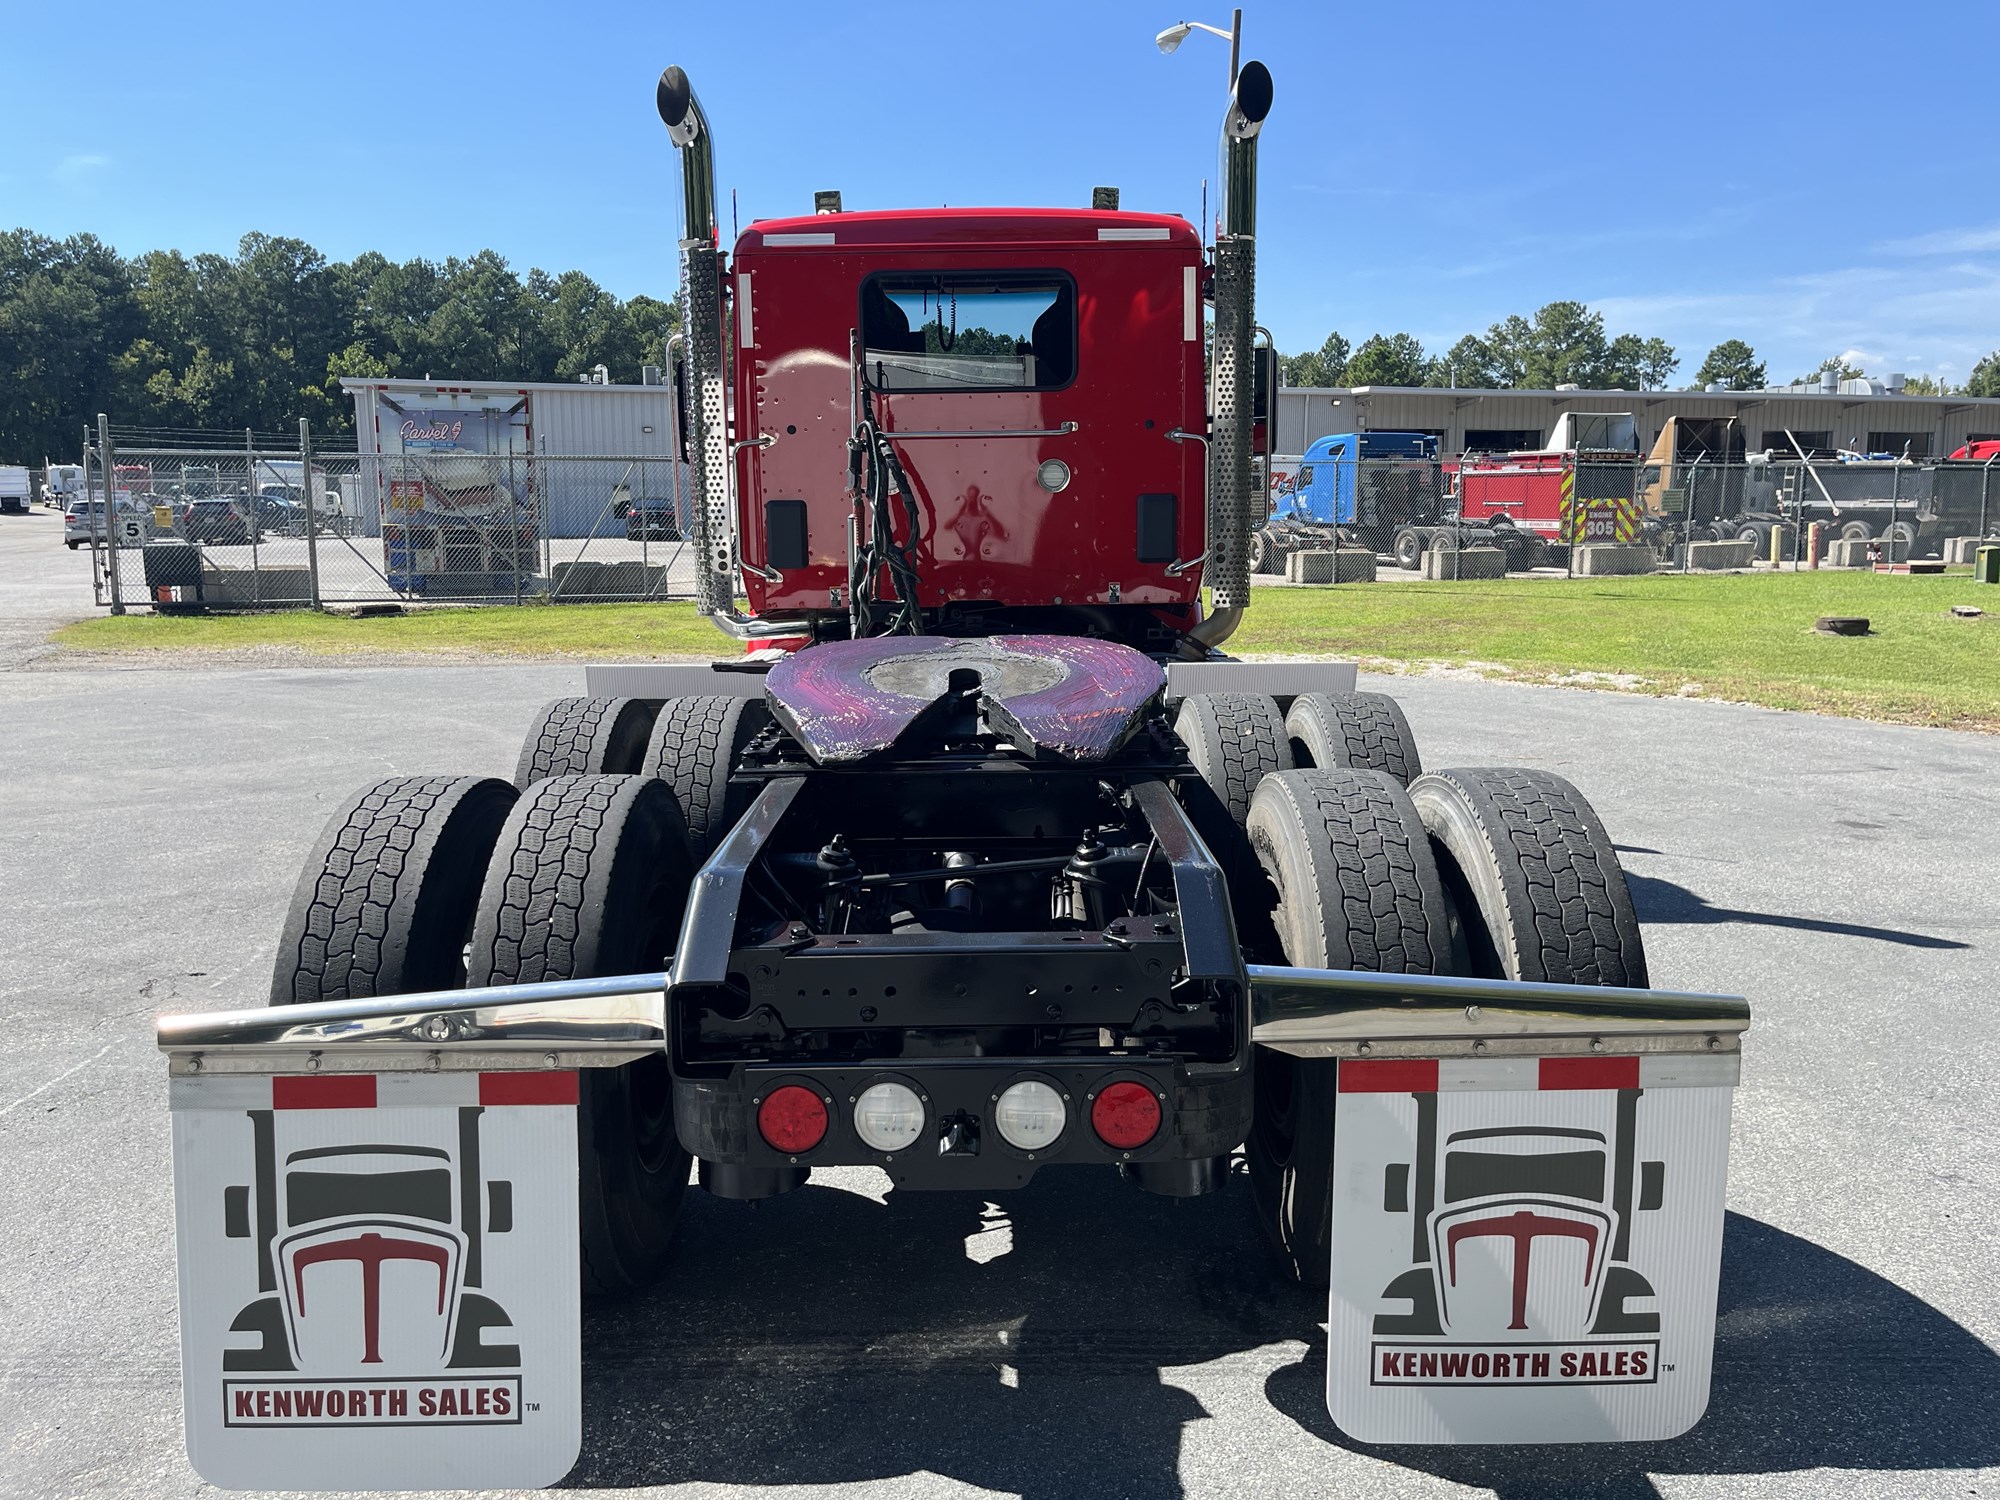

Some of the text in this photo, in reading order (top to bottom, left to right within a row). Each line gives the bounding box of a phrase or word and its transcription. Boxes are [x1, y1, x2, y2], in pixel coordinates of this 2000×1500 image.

[400, 419, 449, 440] Carvel
[1589, 511, 1613, 519] ENGINE
[126, 522, 140, 537] 5
[1586, 521, 1615, 535] 305
[1382, 1351, 1675, 1377] KENWORTH SALES TM
[235, 1387, 540, 1417] KENWORTH SALES TM
